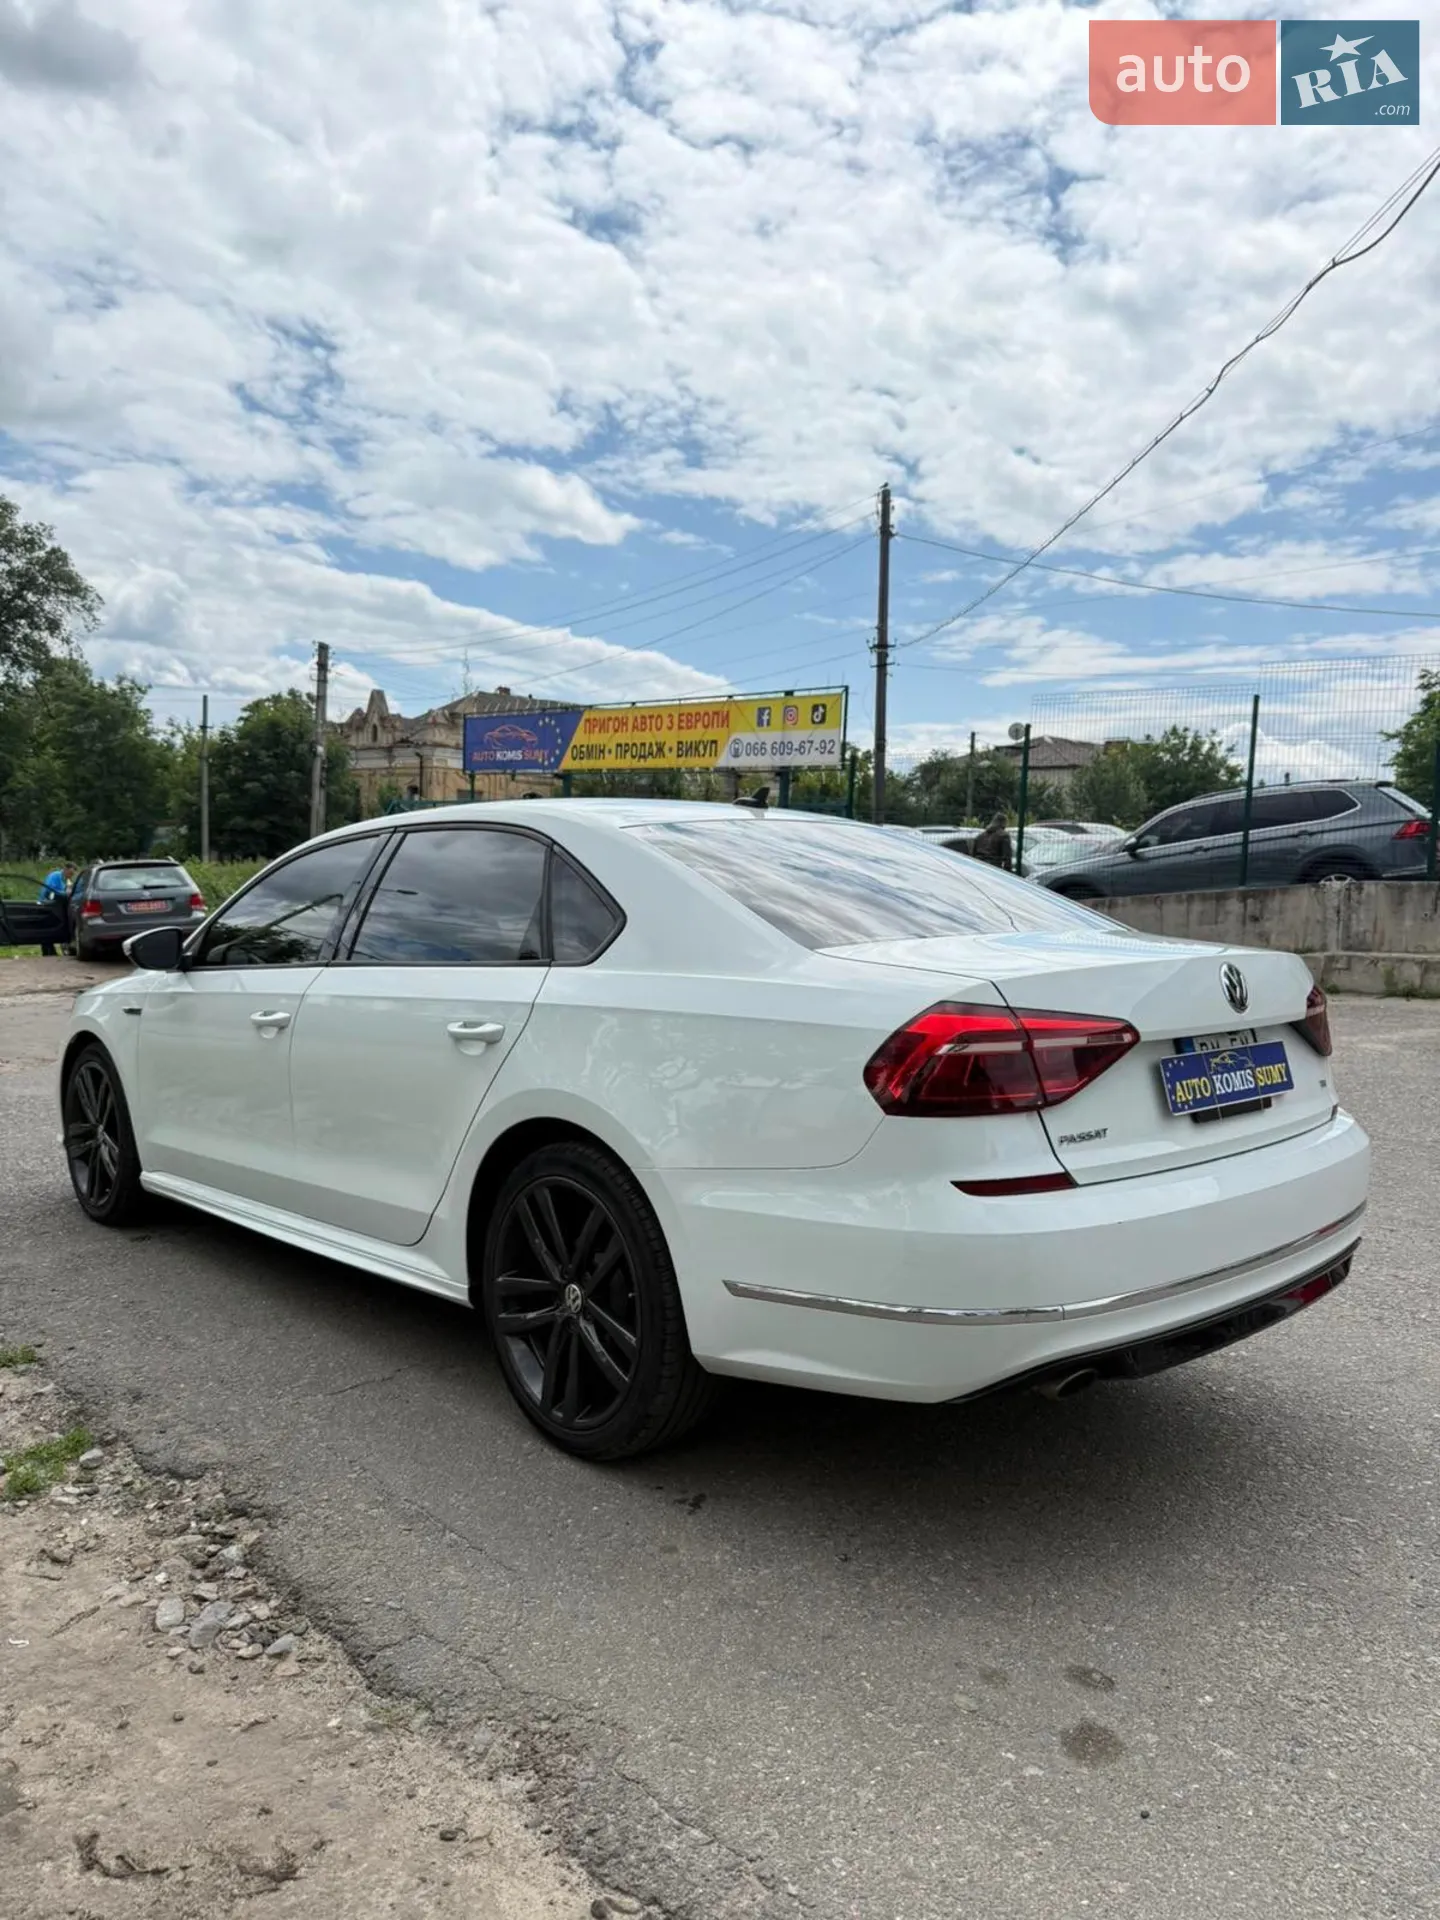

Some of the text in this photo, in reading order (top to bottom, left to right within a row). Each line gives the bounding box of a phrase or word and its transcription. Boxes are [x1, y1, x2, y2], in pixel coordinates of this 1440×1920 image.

[584, 715, 629, 734] ПРИГОН
[632, 714, 663, 732] АВТО
[571, 739, 718, 762] ОБМІН ПРОДАЖ ВИКУП
[745, 739, 836, 757] 066 609-67-92
[1175, 1063, 1288, 1103] AUTO KOMIS SUMY
[1058, 1127, 1109, 1147] PASSAT
